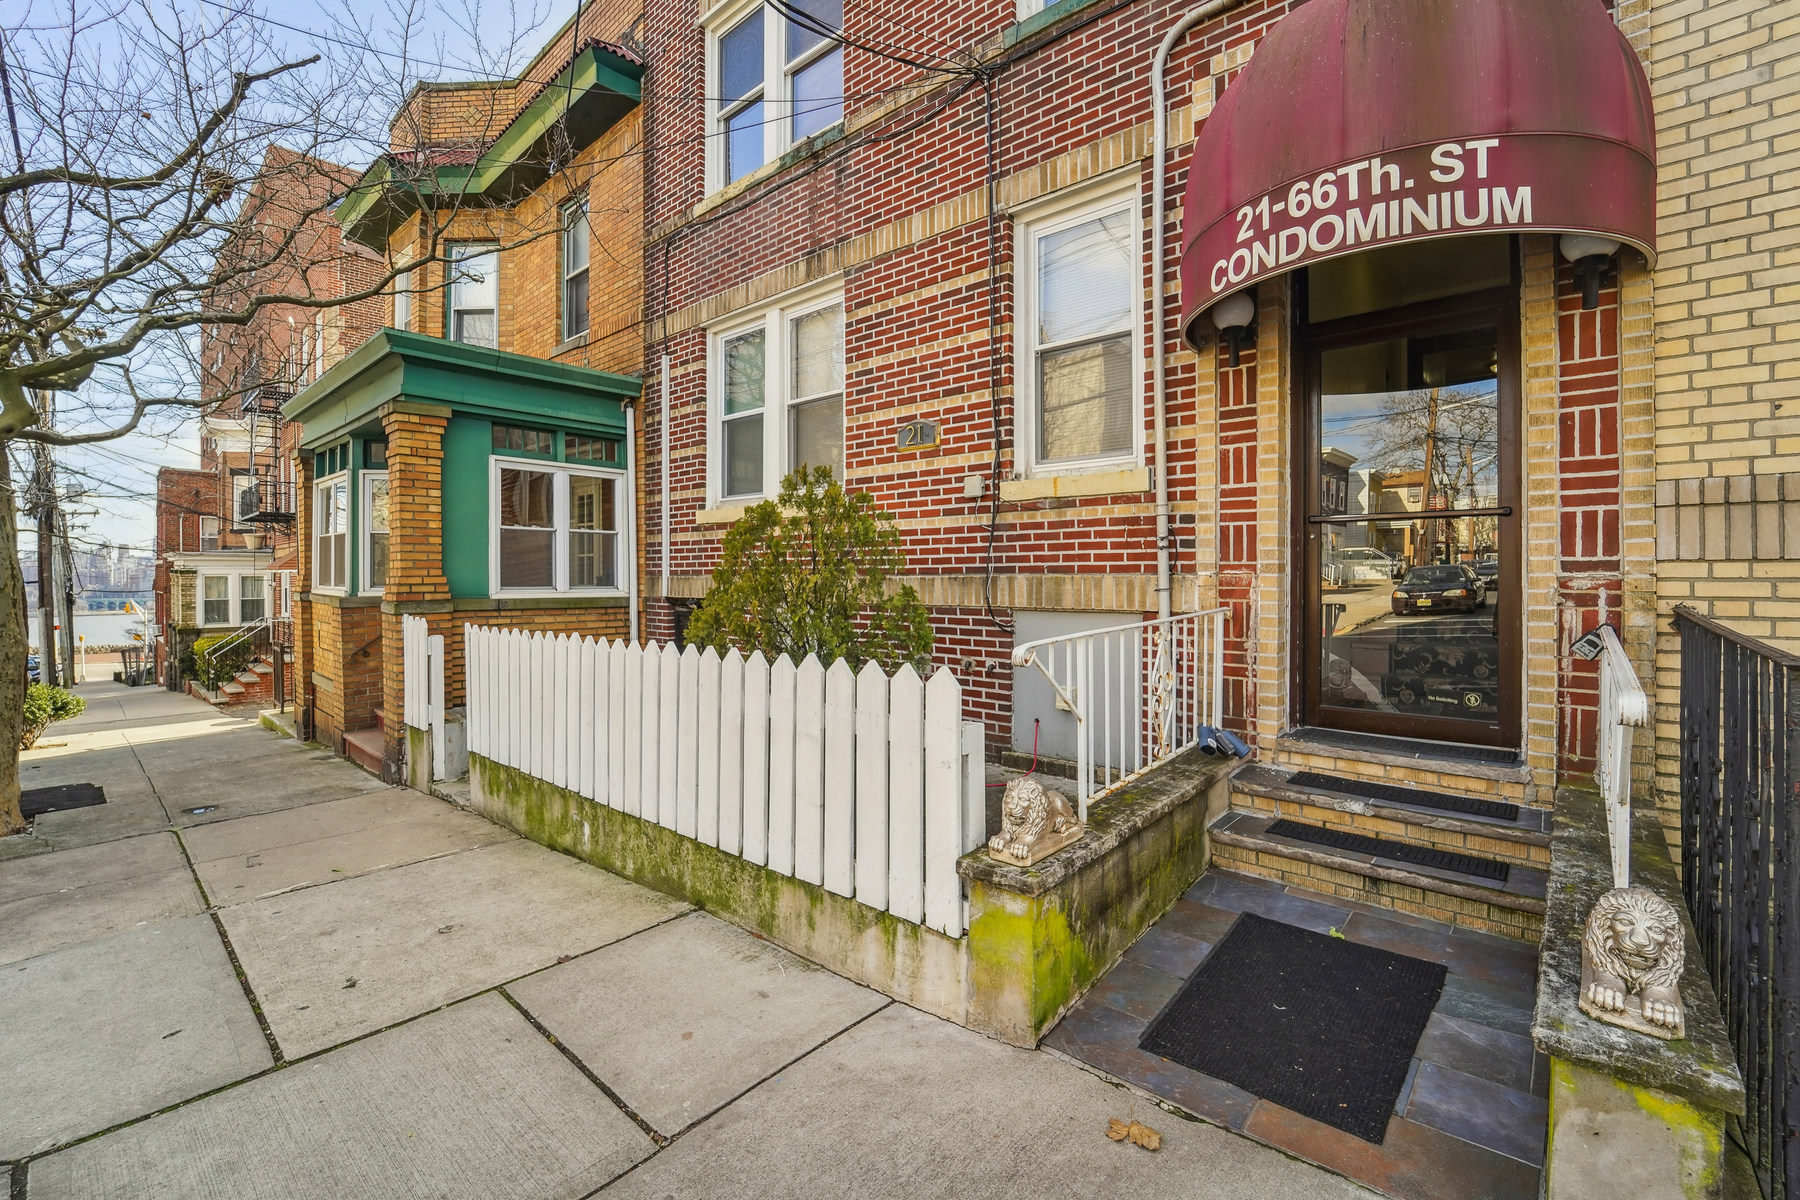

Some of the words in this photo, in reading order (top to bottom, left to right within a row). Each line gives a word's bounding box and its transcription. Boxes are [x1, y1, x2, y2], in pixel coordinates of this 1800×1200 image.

[1210, 186, 1533, 293] CONDOMINIUM
[1236, 157, 1414, 243] 21-66Th.
[1429, 138, 1499, 183] ST
[905, 424, 922, 445] 21
